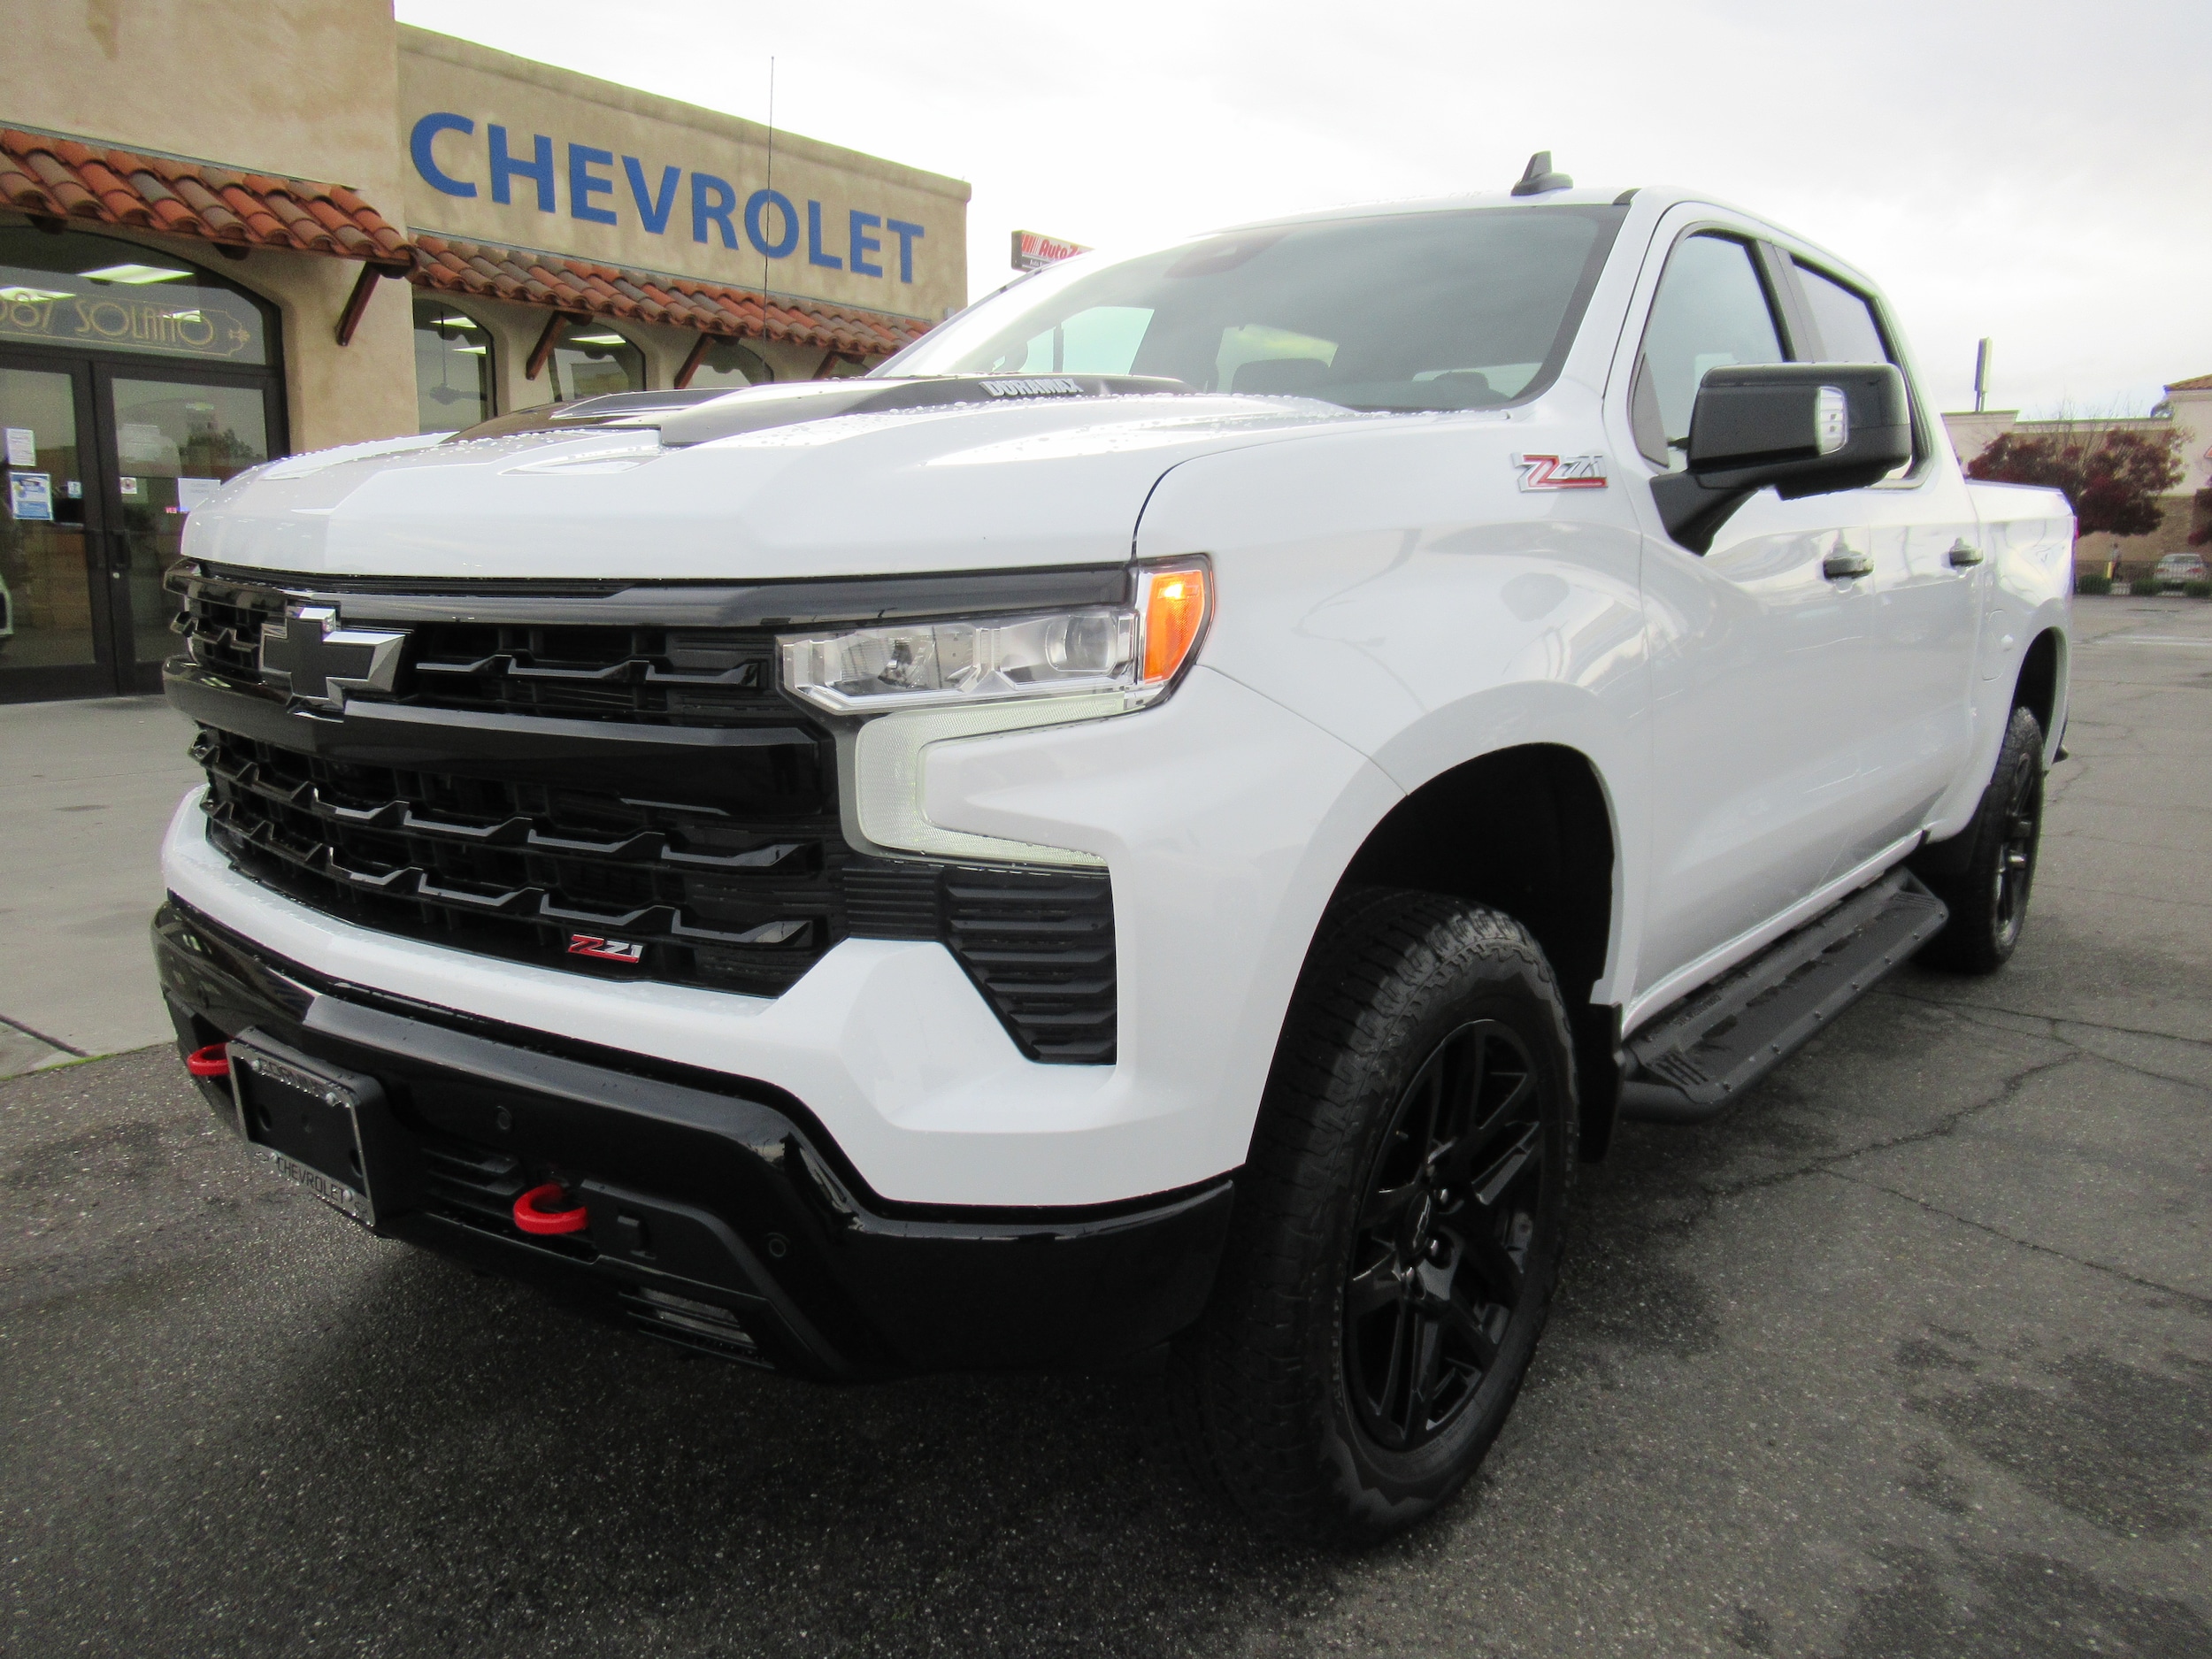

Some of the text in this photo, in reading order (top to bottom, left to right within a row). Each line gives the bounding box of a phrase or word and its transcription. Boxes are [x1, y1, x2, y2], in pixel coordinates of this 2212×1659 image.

[410, 111, 925, 283] CHEVROLET
[74, 297, 215, 346] SOLANO
[979, 378, 1085, 398] DURAMAX
[1511, 452, 1609, 492] Z71
[568, 933, 643, 964] Z71
[275, 1156, 346, 1204] CHEVROLET
